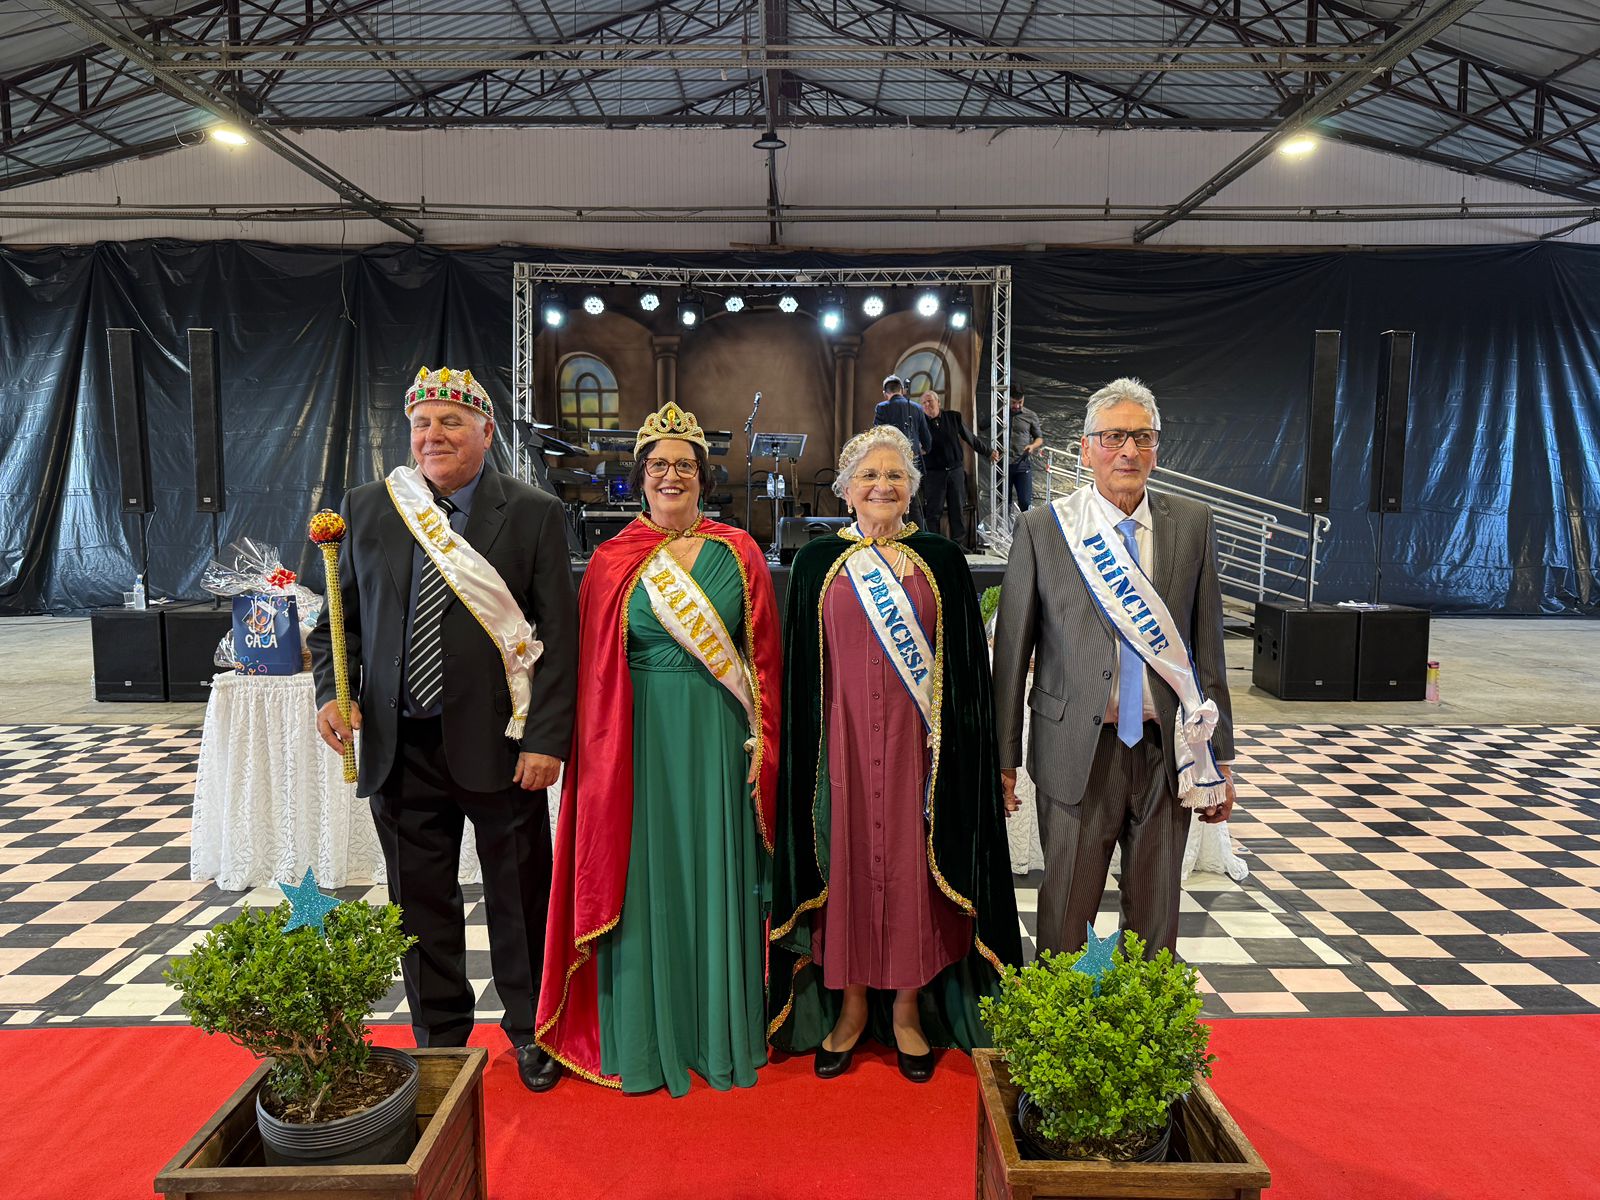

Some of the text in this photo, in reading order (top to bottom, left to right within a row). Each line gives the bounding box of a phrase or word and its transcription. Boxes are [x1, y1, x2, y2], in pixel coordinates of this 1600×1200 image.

[649, 568, 735, 679] RAINHA
[862, 568, 929, 686] PRINCESA
[1083, 533, 1169, 655] PRÍNCIPE
